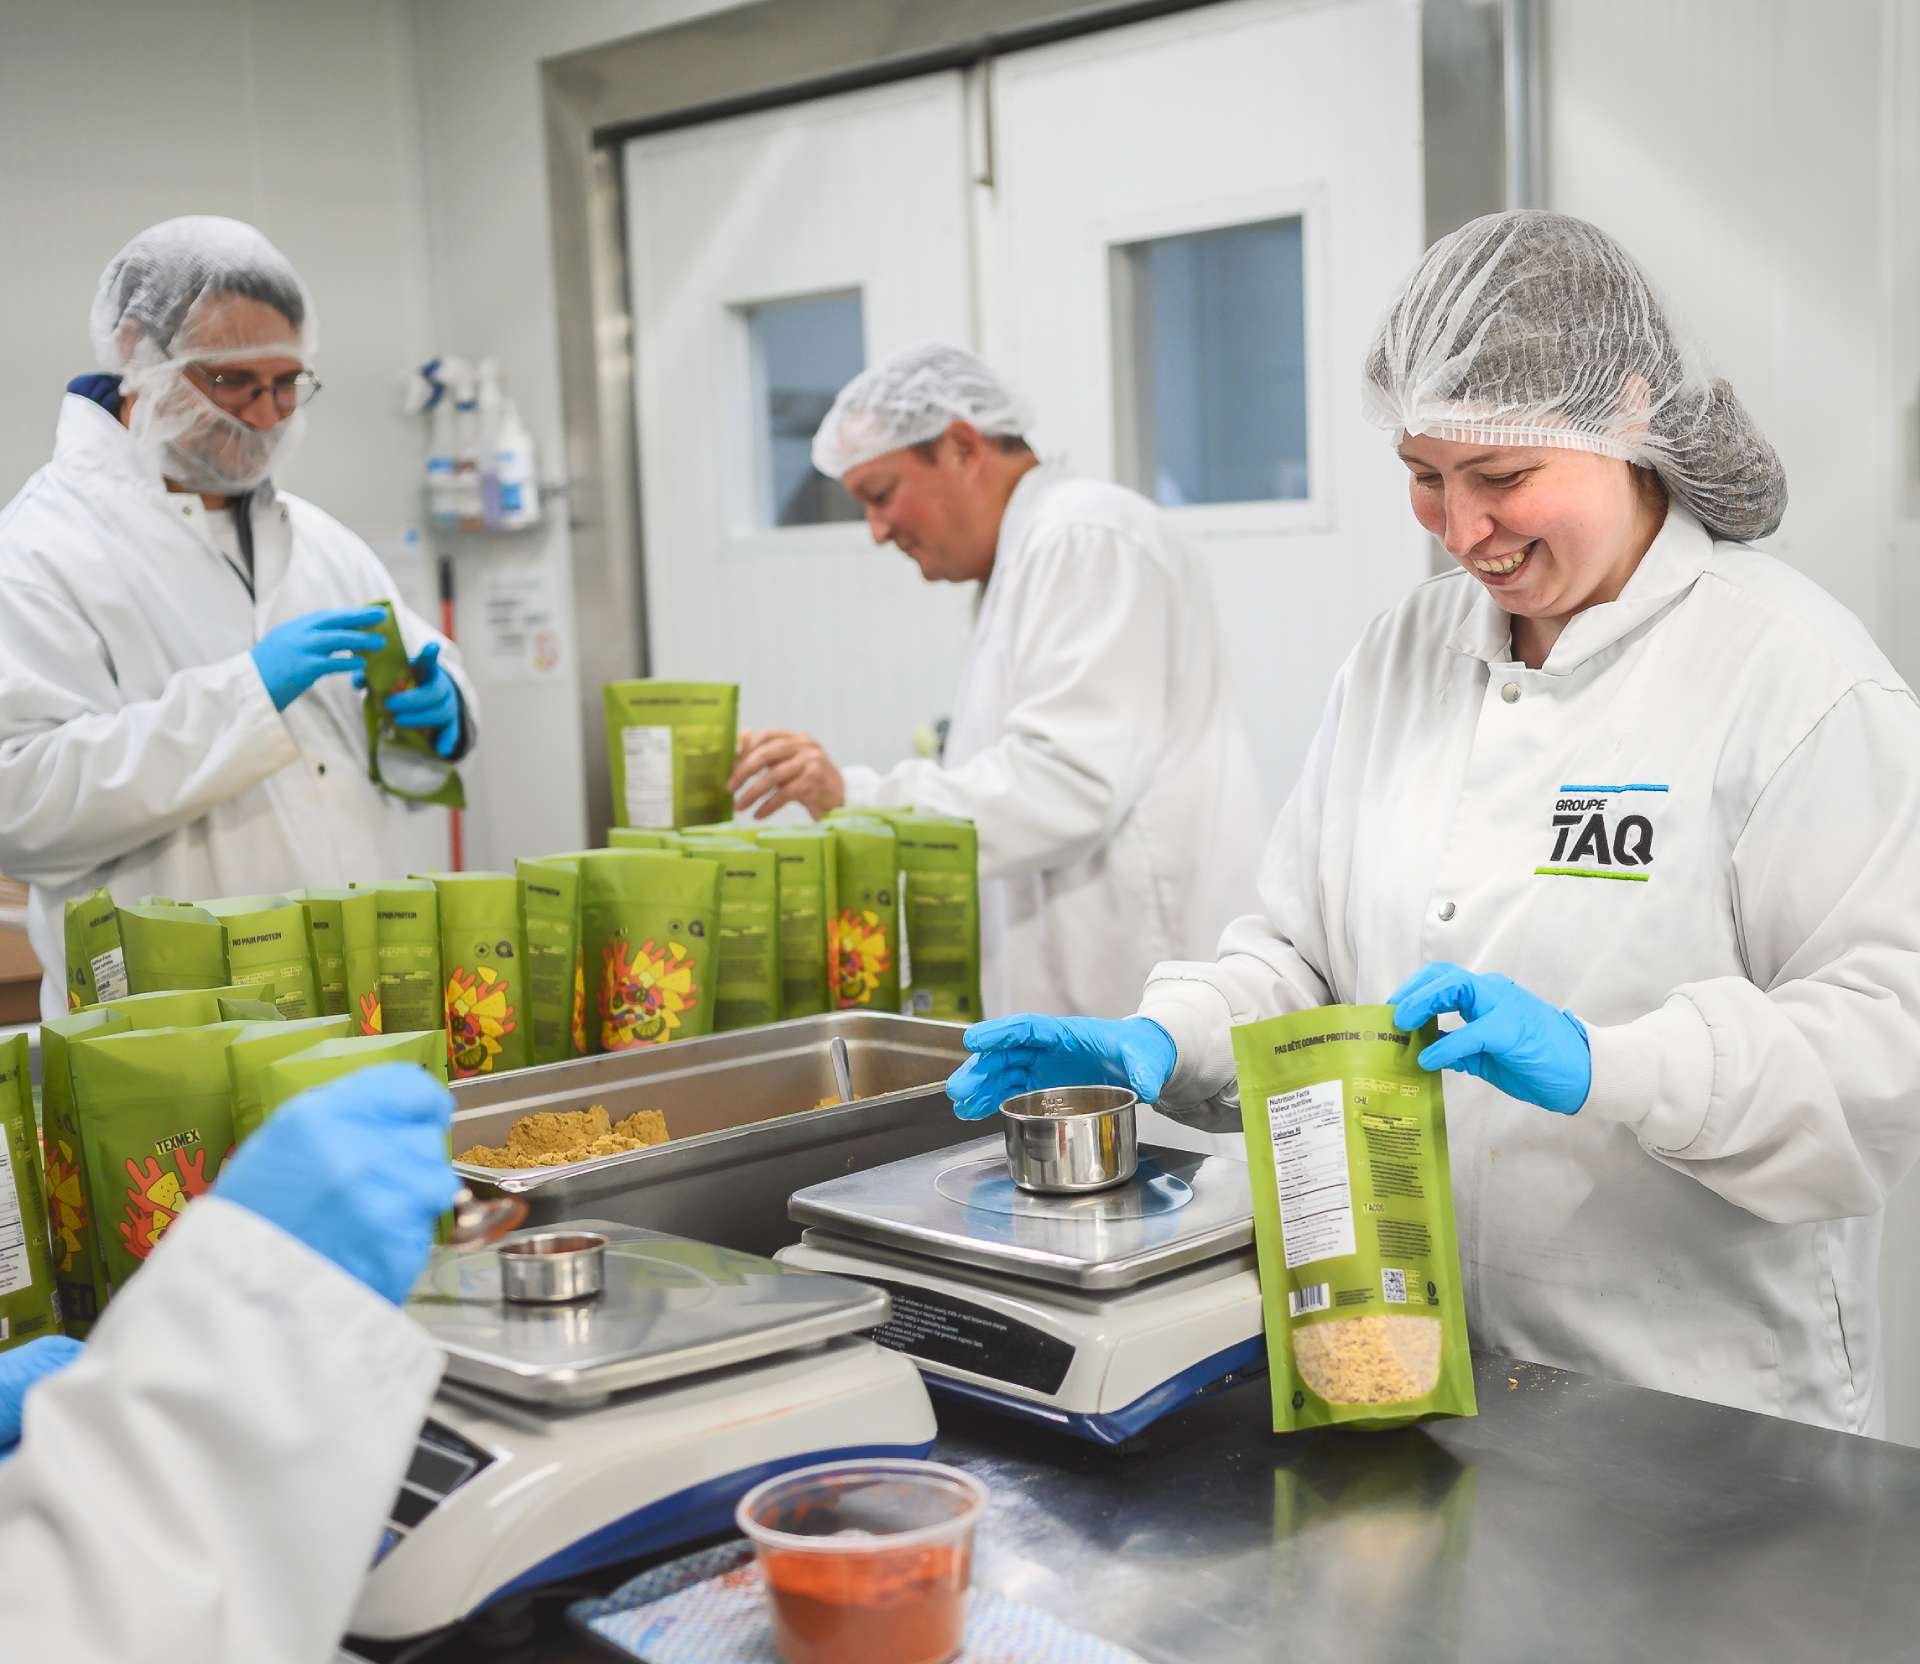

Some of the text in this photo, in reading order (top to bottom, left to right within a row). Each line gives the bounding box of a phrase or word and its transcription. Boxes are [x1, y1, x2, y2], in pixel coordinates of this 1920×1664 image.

[1555, 799, 1608, 811] GROUPE
[1550, 813, 1654, 866] TAQ
[232, 932, 282, 946] NO PAIN PROTEIN
[1274, 1045, 1287, 1055] PAS
[1377, 1032, 1388, 1041] NO
[1269, 1094, 1295, 1106] Nutrition
[1270, 1098, 1312, 1113] Valeur nutritive
[156, 1130, 200, 1154] TEXMEX
